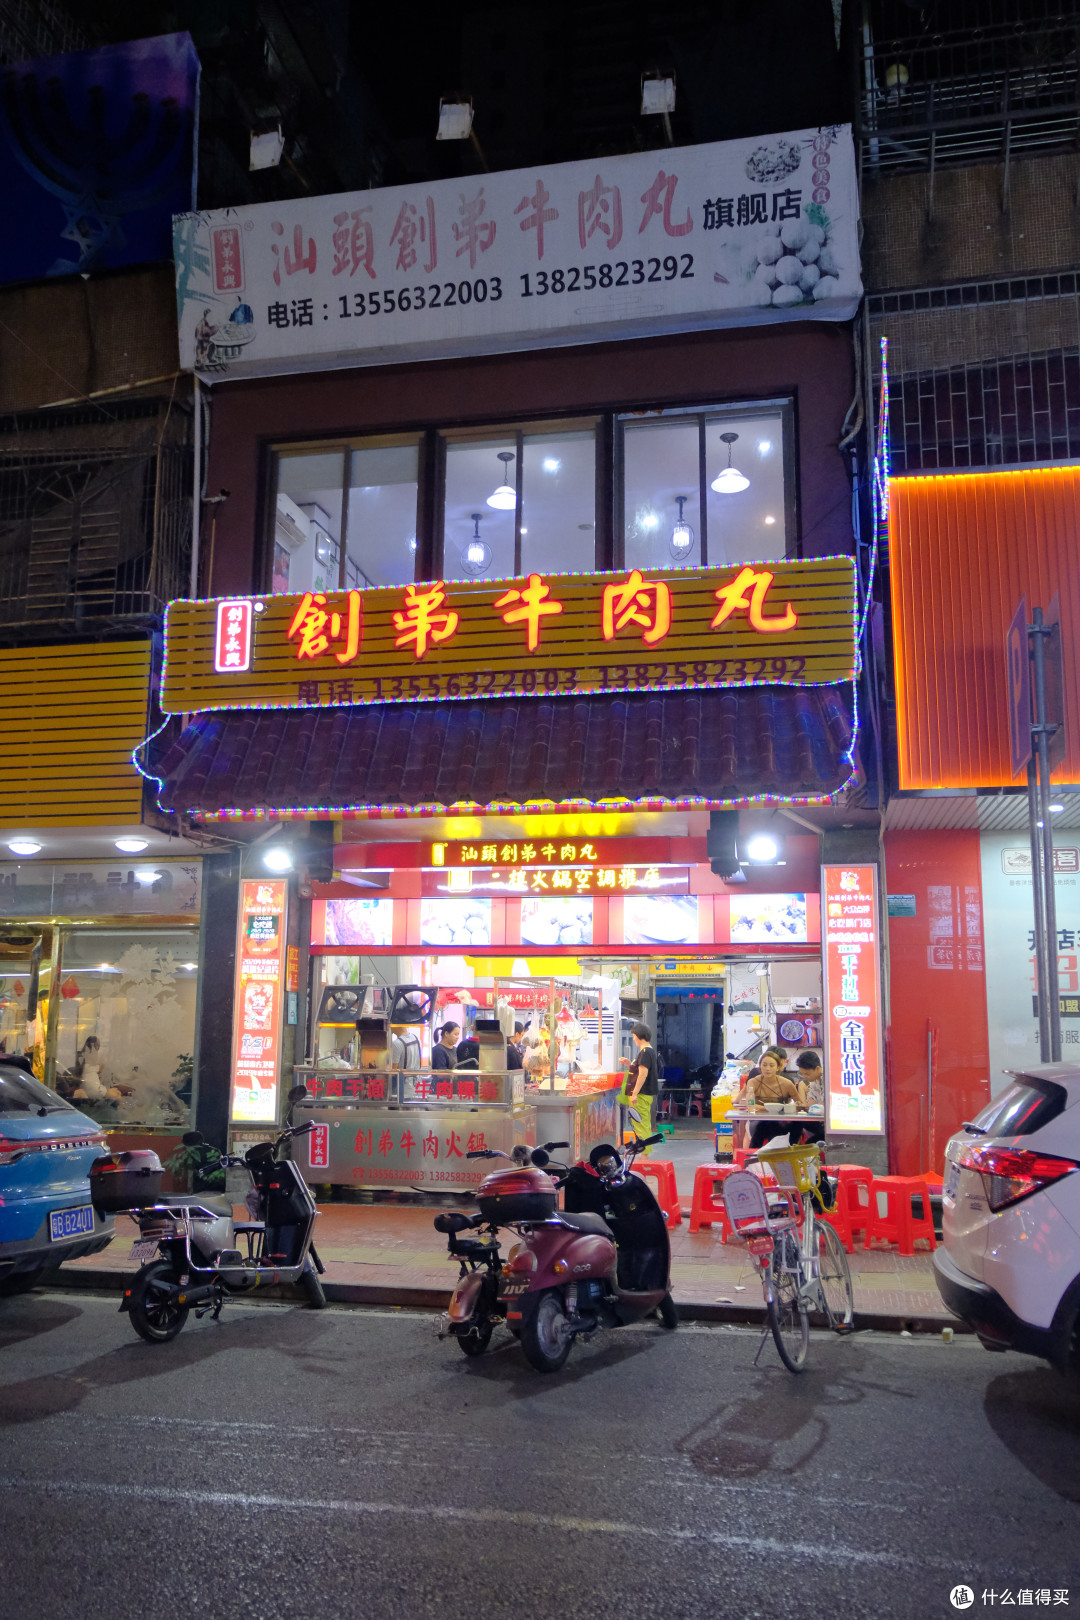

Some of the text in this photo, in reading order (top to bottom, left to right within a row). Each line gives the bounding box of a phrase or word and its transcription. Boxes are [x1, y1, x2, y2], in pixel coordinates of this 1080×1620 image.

[269, 169, 803, 287] 汕頭創弟牛肉丸 旗舰店
[519, 253, 695, 297] 13825823292
[287, 566, 799, 664] 創弟牛肉丸
[599, 655, 807, 690] 13825823292
[461, 842, 598, 863] 汕頭創弟牛肉丸
[842, 1020, 864, 1086] 全国代邮
[306, 1078, 385, 1098] 牛肉干面
[368, 1168, 425, 1181] 13556322003
